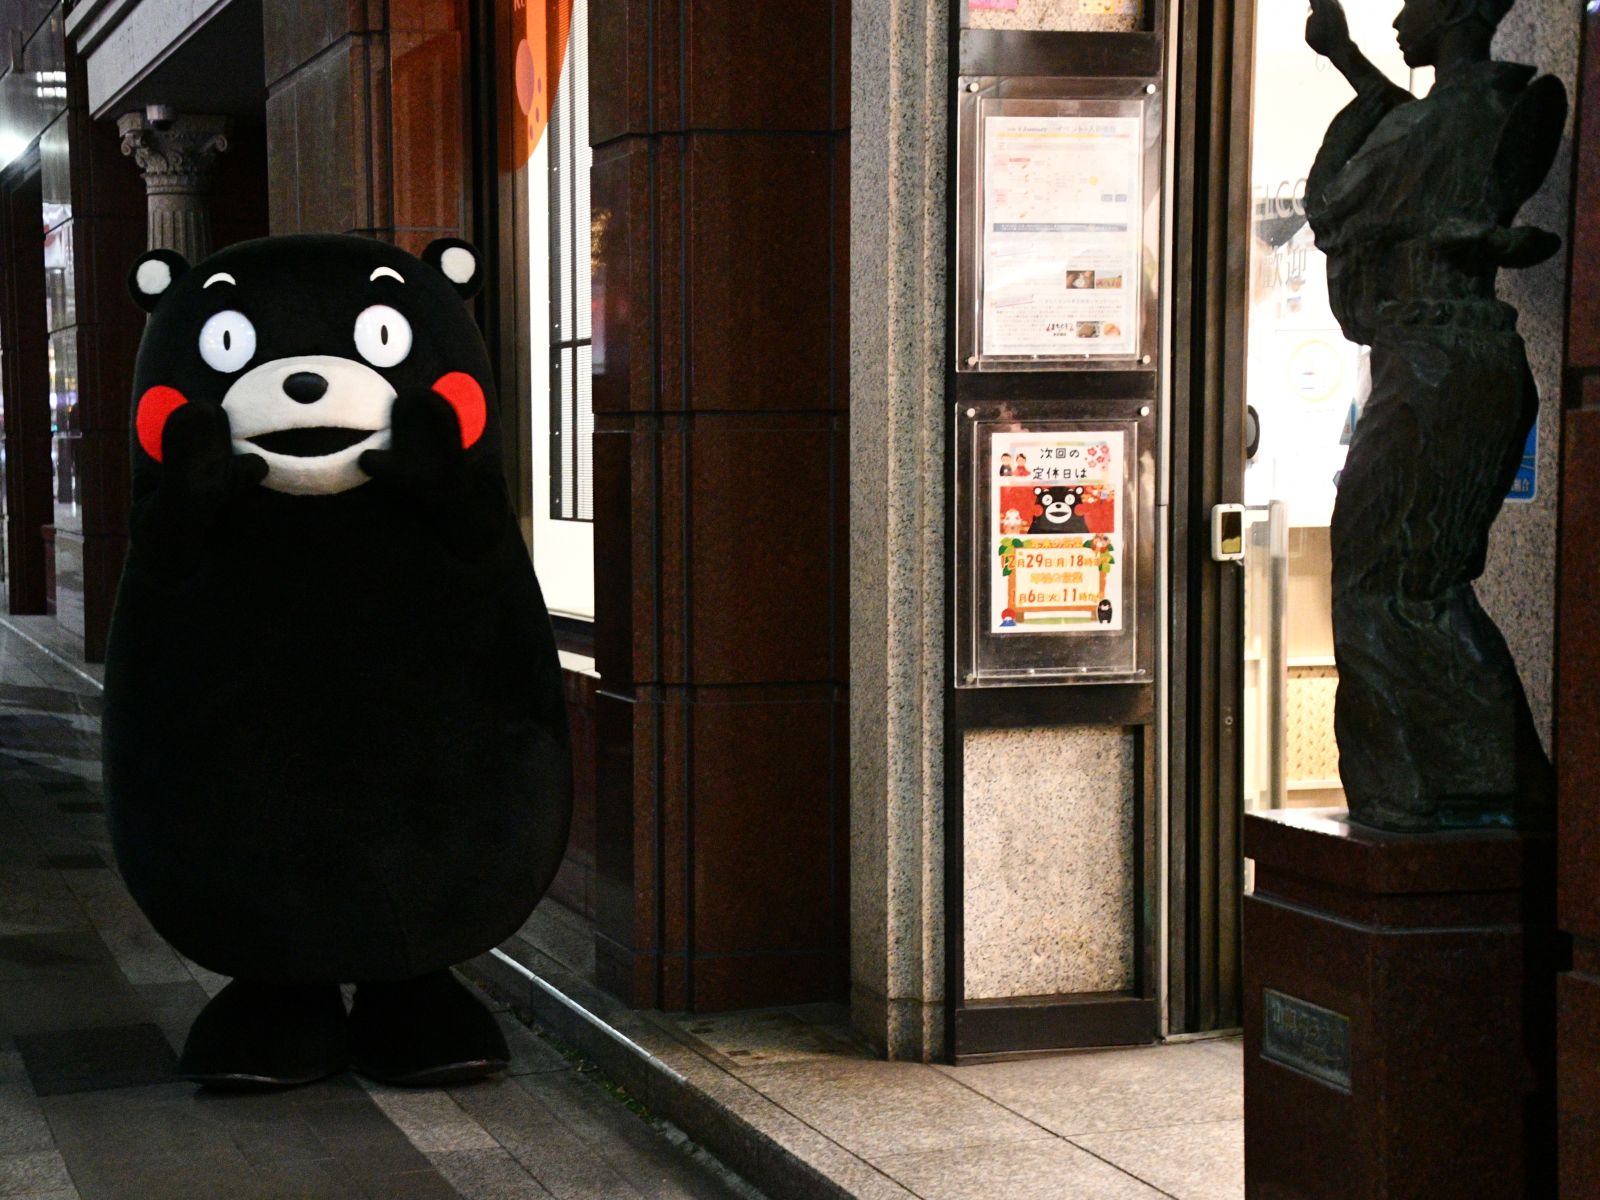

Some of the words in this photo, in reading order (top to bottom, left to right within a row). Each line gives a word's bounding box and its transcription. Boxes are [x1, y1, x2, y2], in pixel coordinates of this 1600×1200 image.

[1040, 447, 1080, 459] 次回の
[1032, 467, 1088, 480] 定休日は
